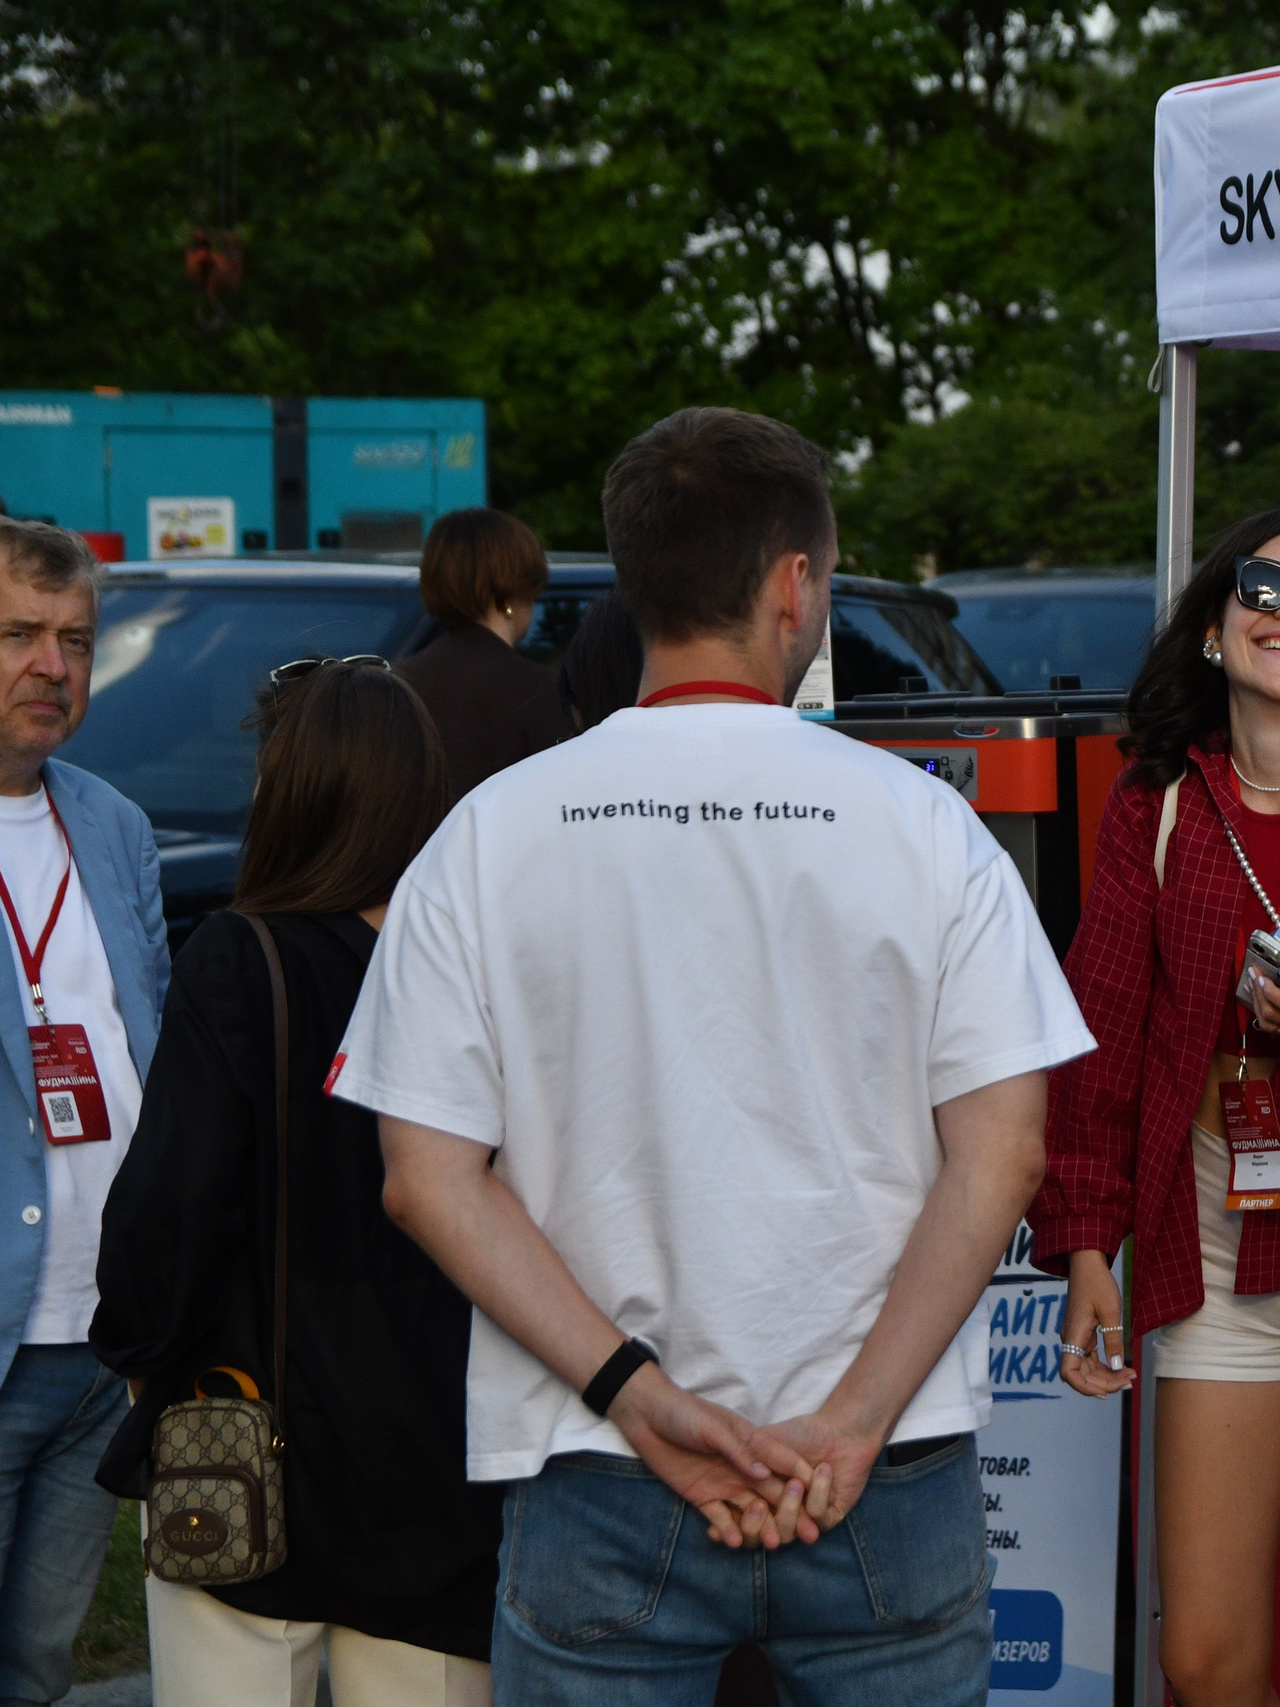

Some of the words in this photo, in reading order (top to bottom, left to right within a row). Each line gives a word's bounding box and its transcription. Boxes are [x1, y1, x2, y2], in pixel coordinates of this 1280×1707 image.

[562, 799, 690, 824] inventing
[700, 801, 744, 821] the
[754, 801, 836, 822] future
[1239, 1198, 1274, 1209] ПАРТНЕР
[978, 1456, 1031, 1477] ТОВАР.
[170, 1530, 218, 1543] GUCCI
